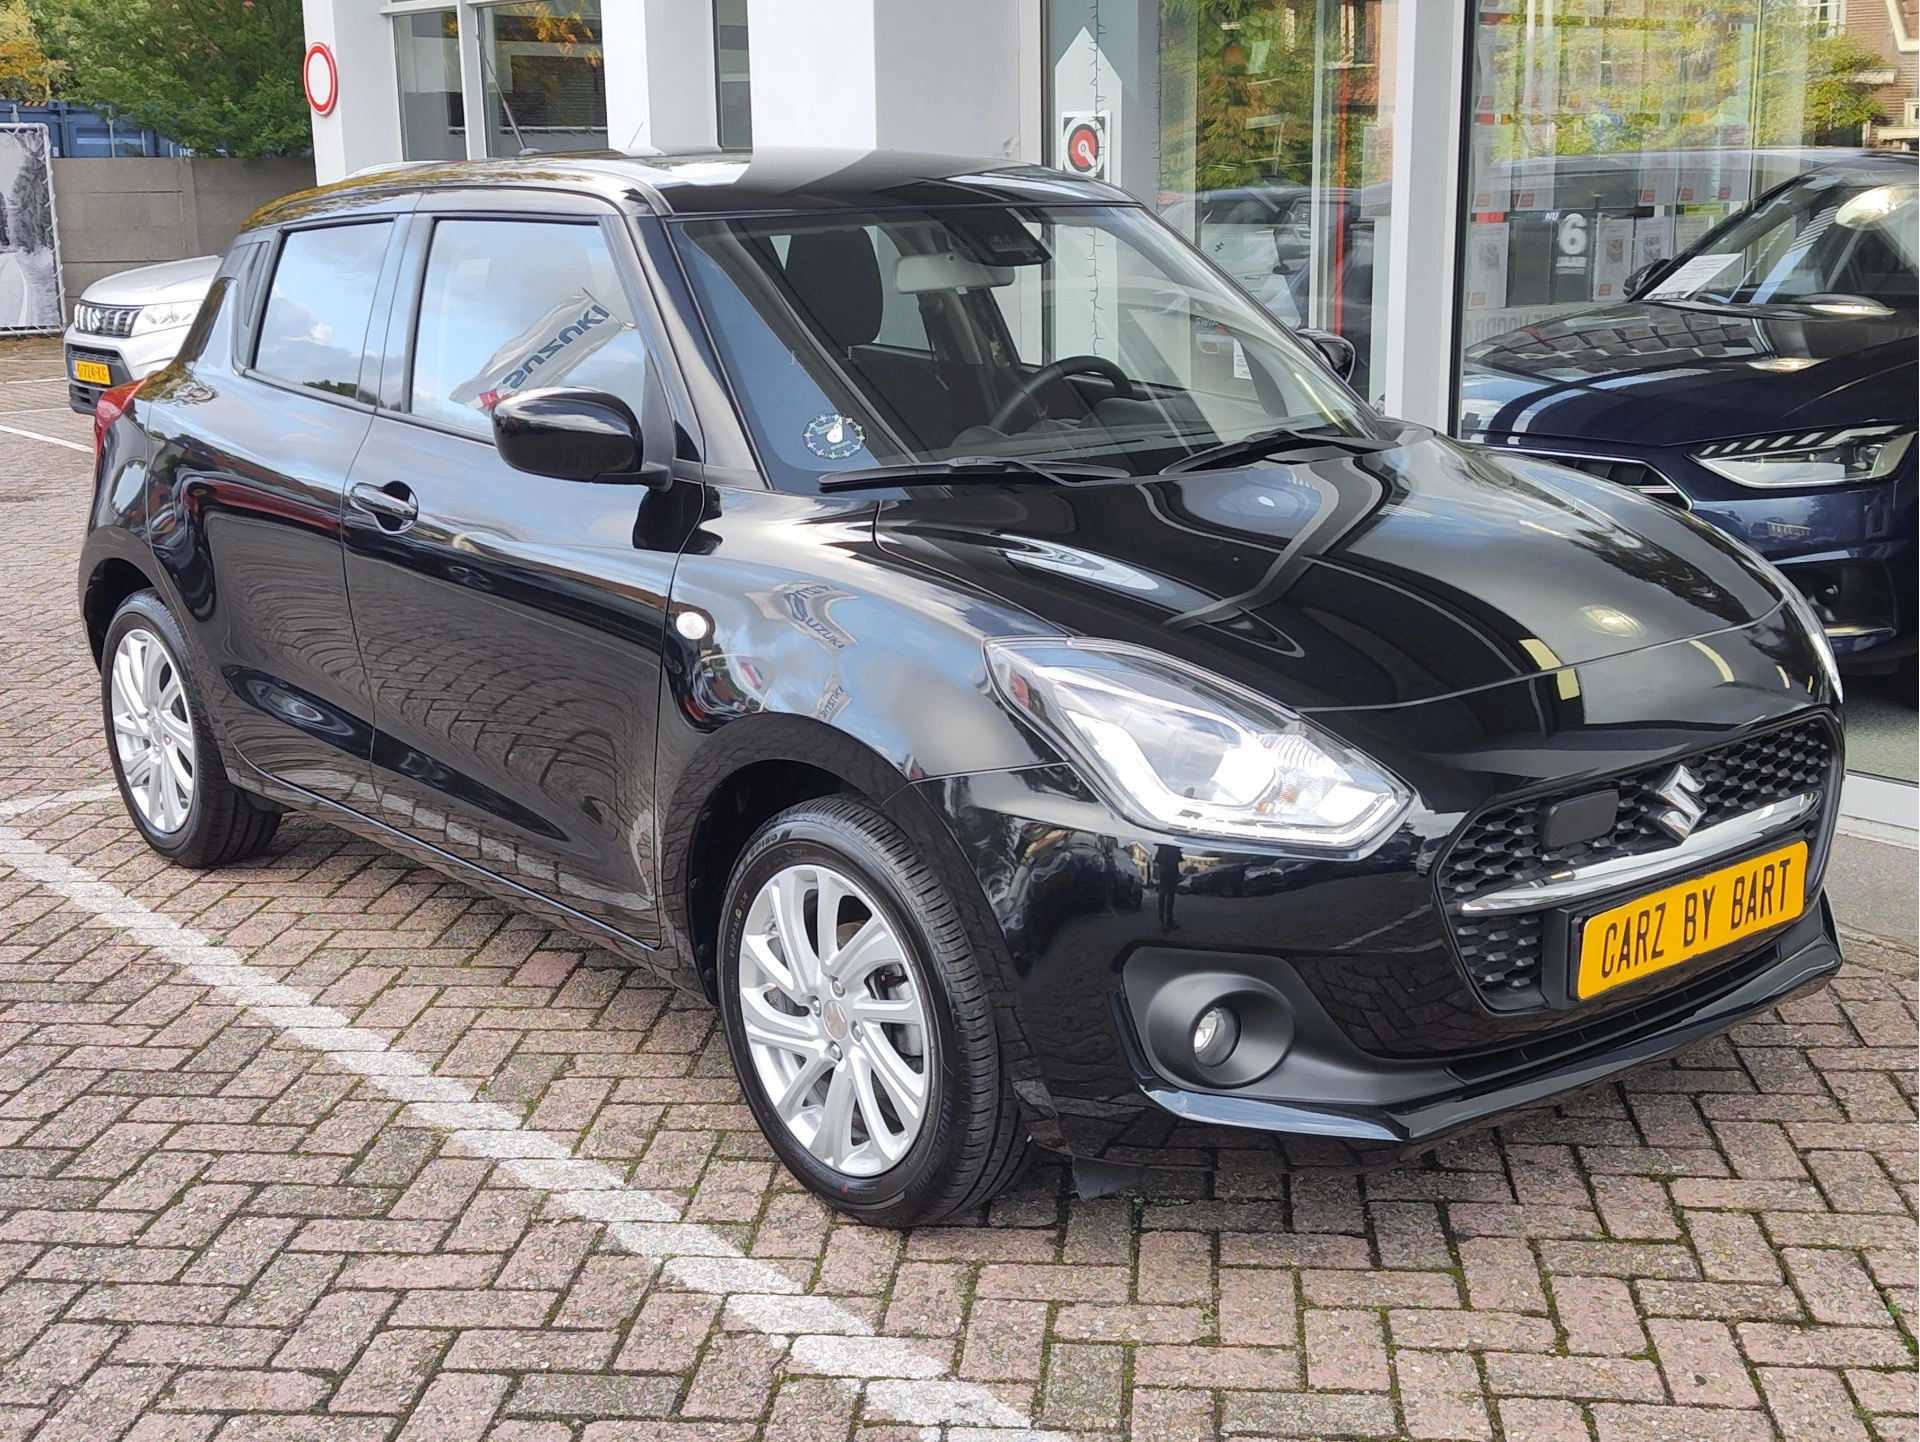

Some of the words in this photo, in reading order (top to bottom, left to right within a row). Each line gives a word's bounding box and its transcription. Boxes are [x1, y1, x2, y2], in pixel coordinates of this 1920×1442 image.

[1544, 212, 1560, 221] NU
[1560, 213, 1587, 255] 6
[1600, 902, 1667, 979] CARZ
[1683, 885, 1717, 948] BY
[1731, 857, 1792, 931] BART
